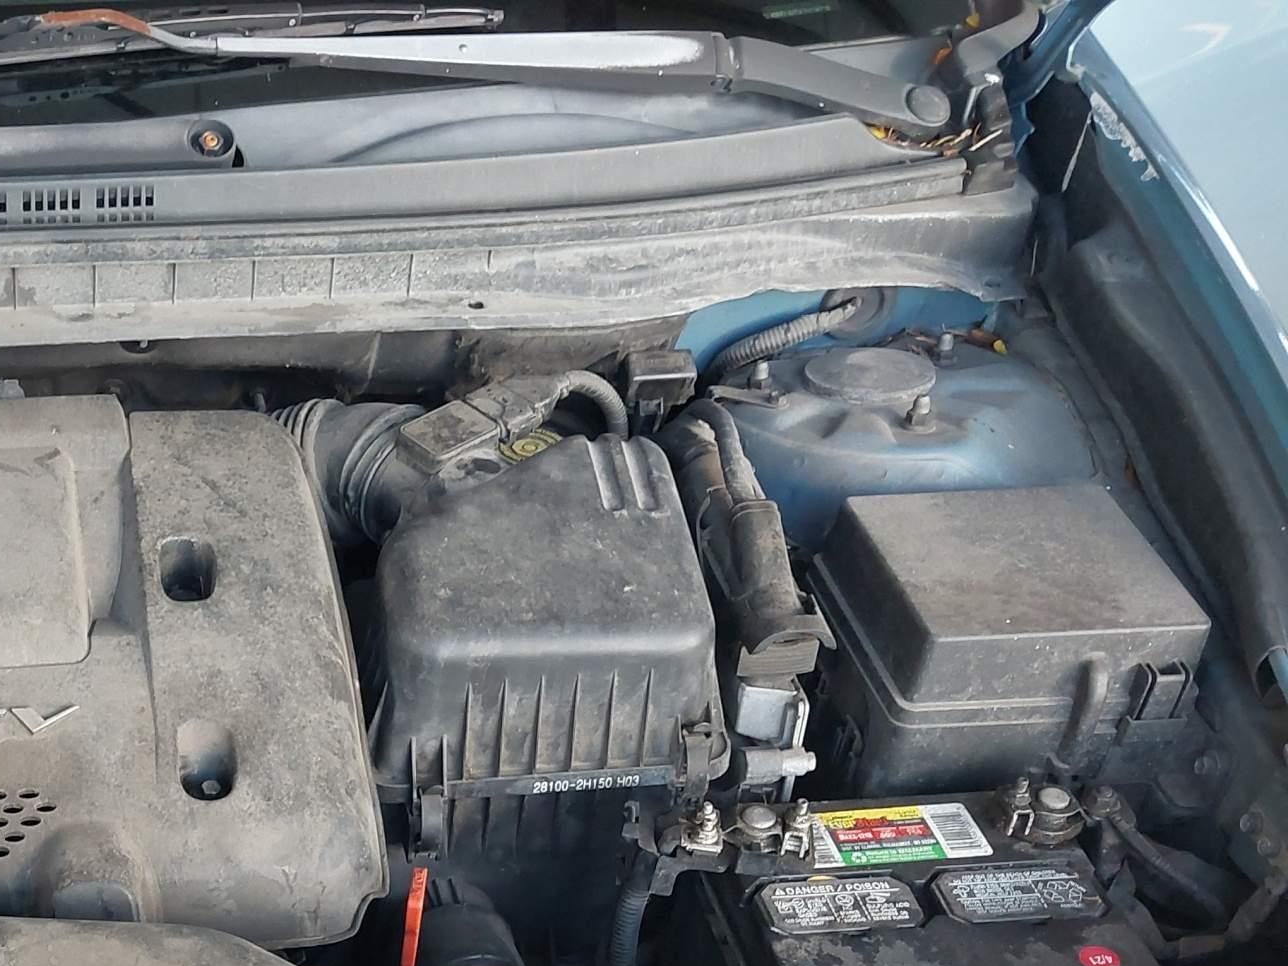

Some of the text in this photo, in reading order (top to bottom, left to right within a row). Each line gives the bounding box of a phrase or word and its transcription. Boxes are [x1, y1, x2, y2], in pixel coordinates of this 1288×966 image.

[532, 775, 640, 794] 28100-2H150 H03
[785, 884, 835, 895] DANGER
[847, 881, 890, 891] POISON
